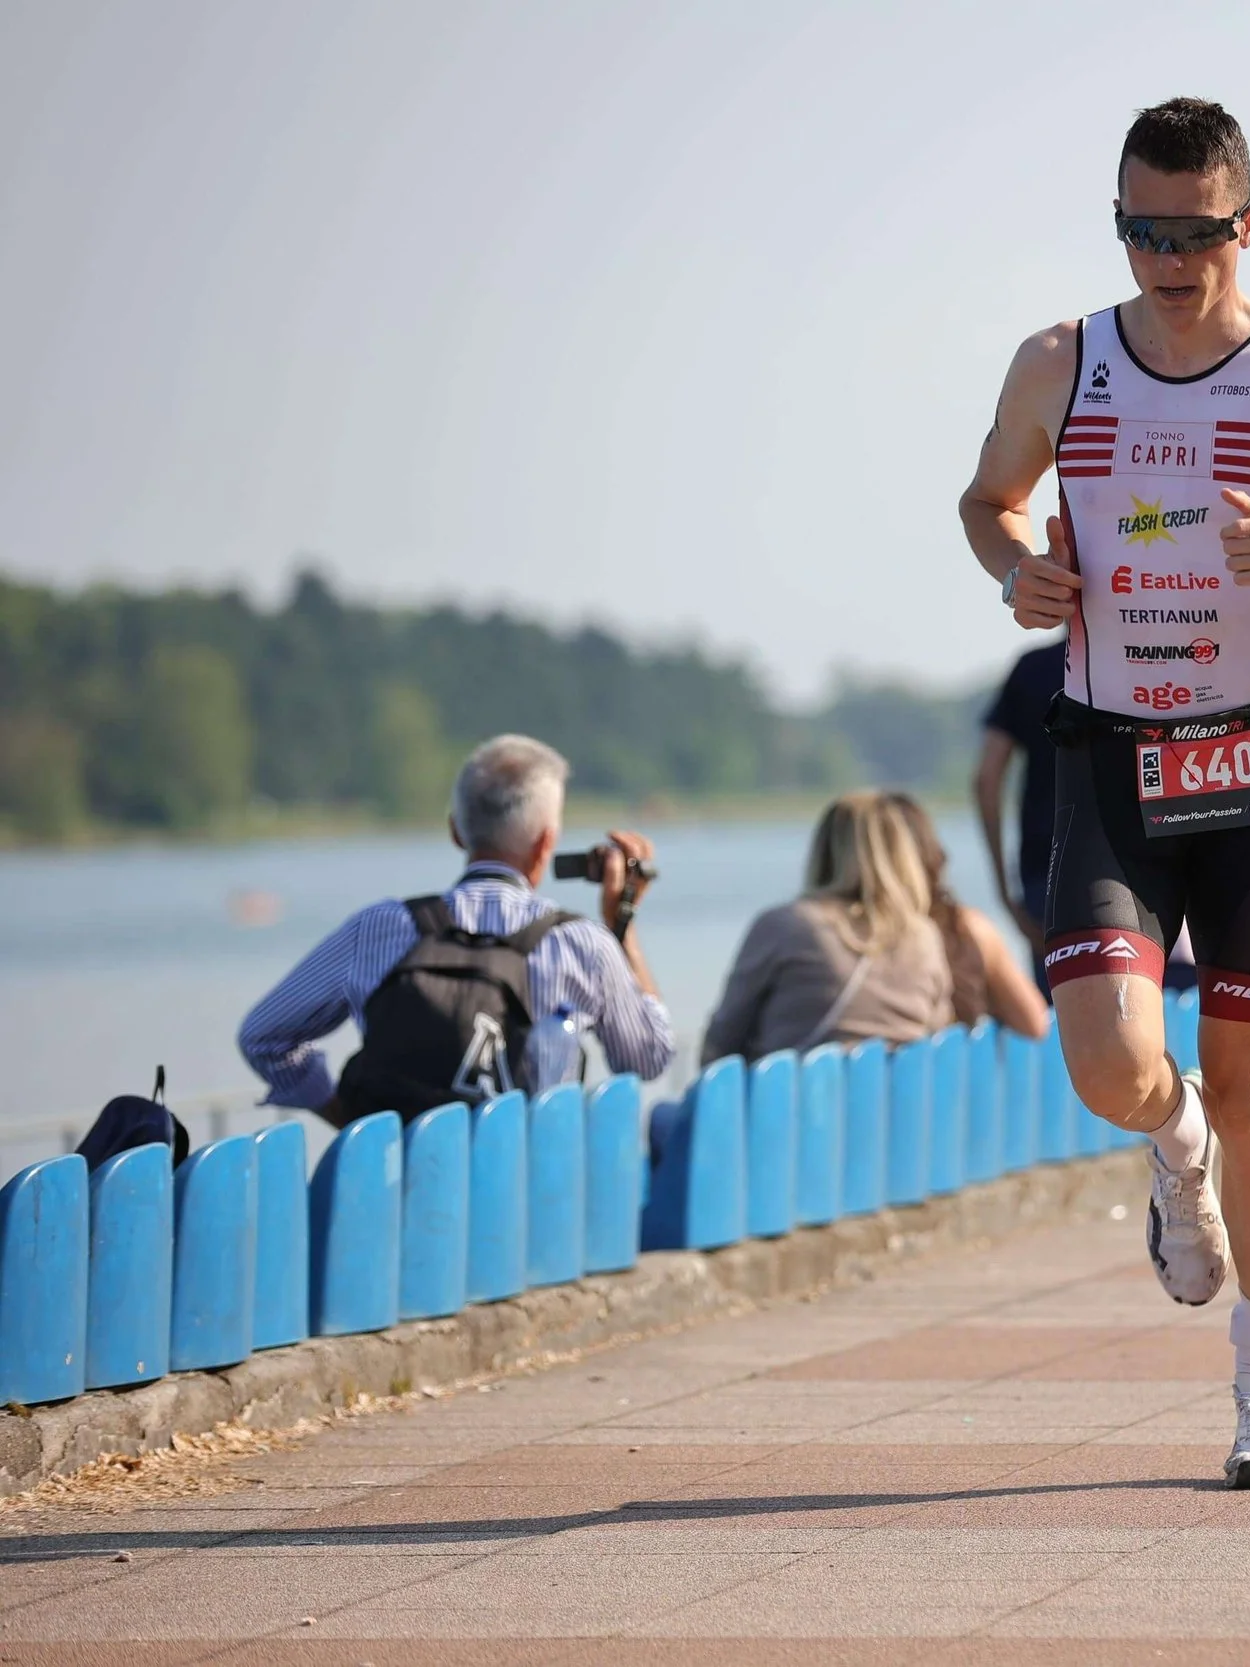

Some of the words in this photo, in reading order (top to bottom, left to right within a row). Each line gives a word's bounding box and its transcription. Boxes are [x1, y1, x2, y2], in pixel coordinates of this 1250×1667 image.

[1146, 431, 1185, 442] TONNO
[1131, 444, 1196, 467] CAPRI
[1117, 515, 1157, 535] FLASH
[1161, 507, 1209, 528] CREDIT
[1140, 573, 1220, 590] EatLive
[1119, 609, 1219, 624] TERTIANUM
[1124, 643, 1220, 660] TRAINING991
[1133, 682, 1191, 710] age
[1162, 807, 1242, 823] FollowYourPassion
